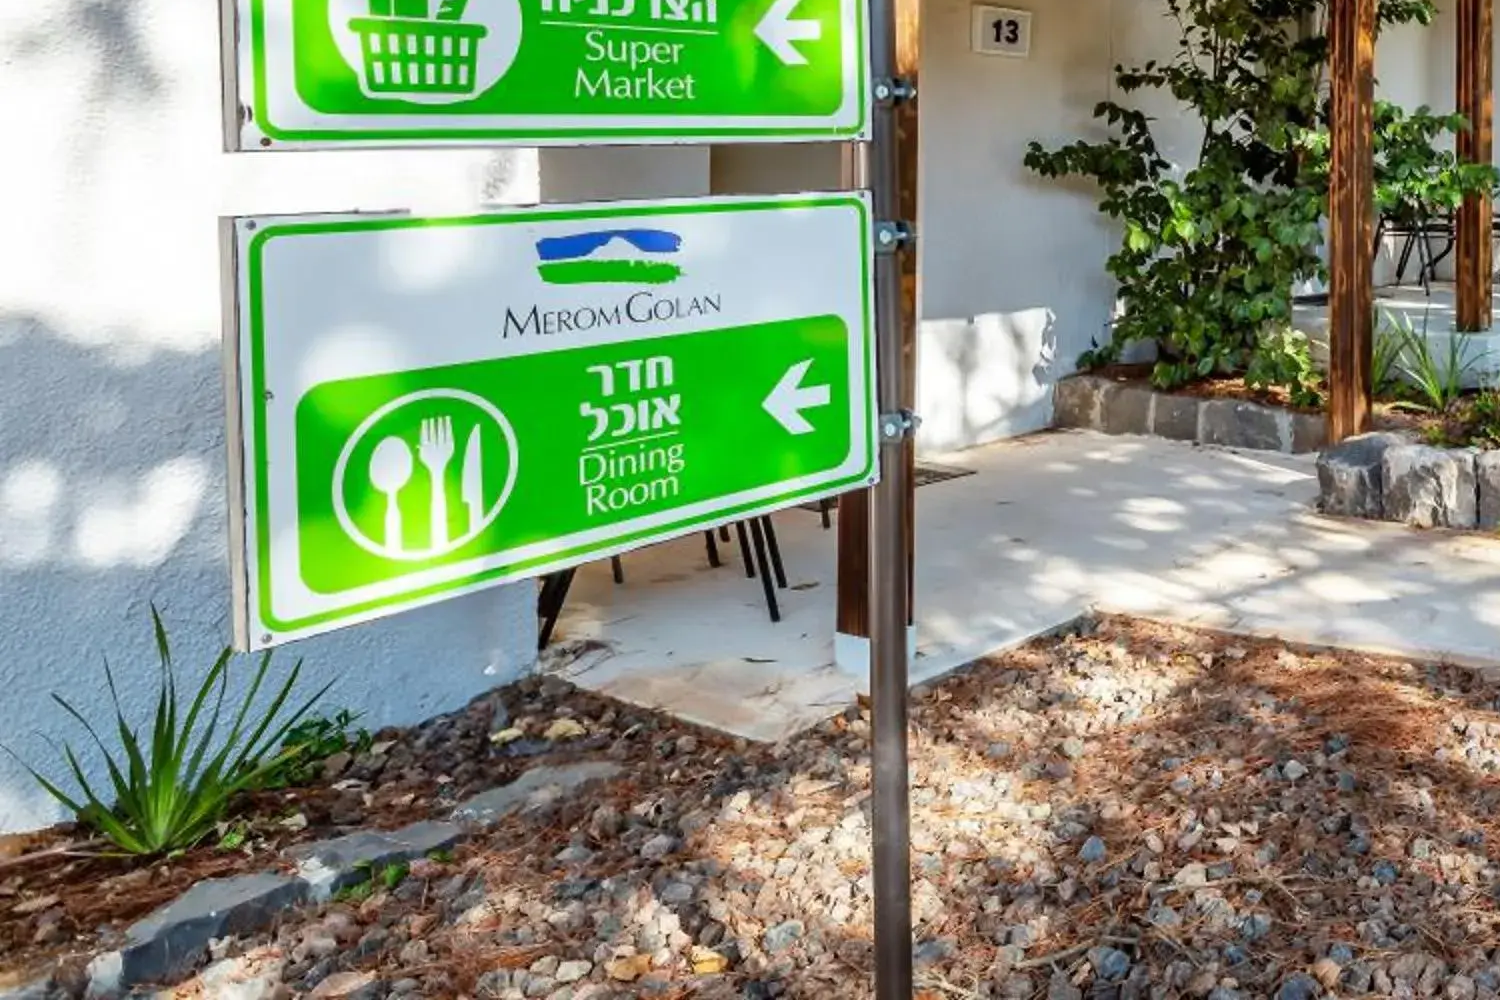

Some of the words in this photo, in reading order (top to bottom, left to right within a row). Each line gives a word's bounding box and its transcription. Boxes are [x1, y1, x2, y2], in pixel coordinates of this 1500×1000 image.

[585, 29, 684, 71] Super
[992, 18, 1019, 45] 13
[574, 67, 696, 99] Market
[586, 355, 674, 397] חדר
[579, 394, 681, 441] אוכל
[579, 443, 685, 486] Dining
[586, 476, 679, 516] Room
